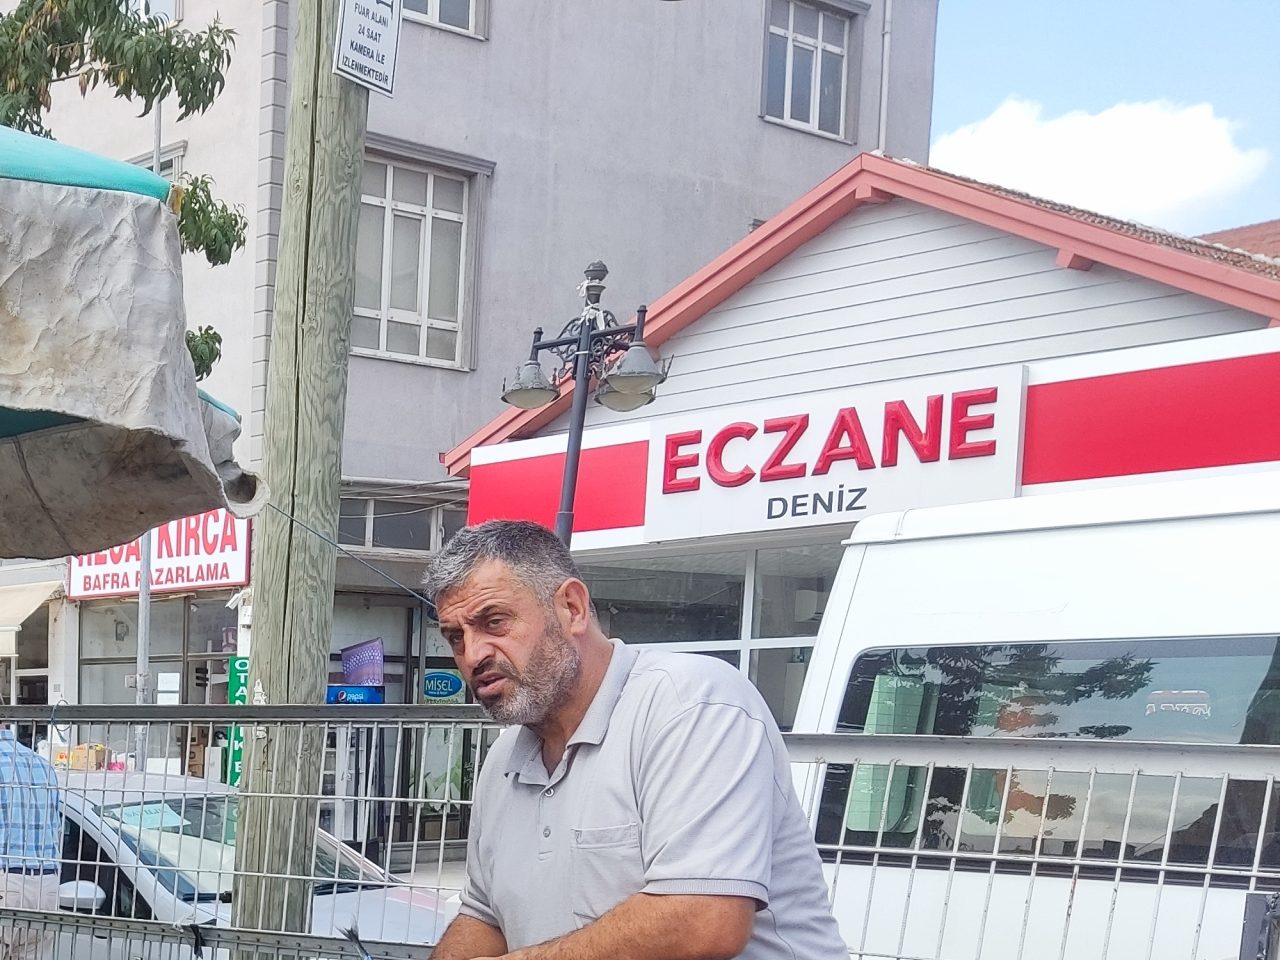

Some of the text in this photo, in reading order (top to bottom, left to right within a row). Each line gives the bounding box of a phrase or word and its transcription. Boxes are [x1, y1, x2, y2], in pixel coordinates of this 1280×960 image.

[354, 3, 389, 28] FUAR ALANI
[358, 24, 382, 44] 24 SAAT
[350, 40, 375, 60] KAMERA
[662, 386, 998, 494] ECZANE
[767, 484, 868, 520] DENİZ
[157, 511, 238, 559] KIRCA
[83, 572, 130, 592] BAFRA
